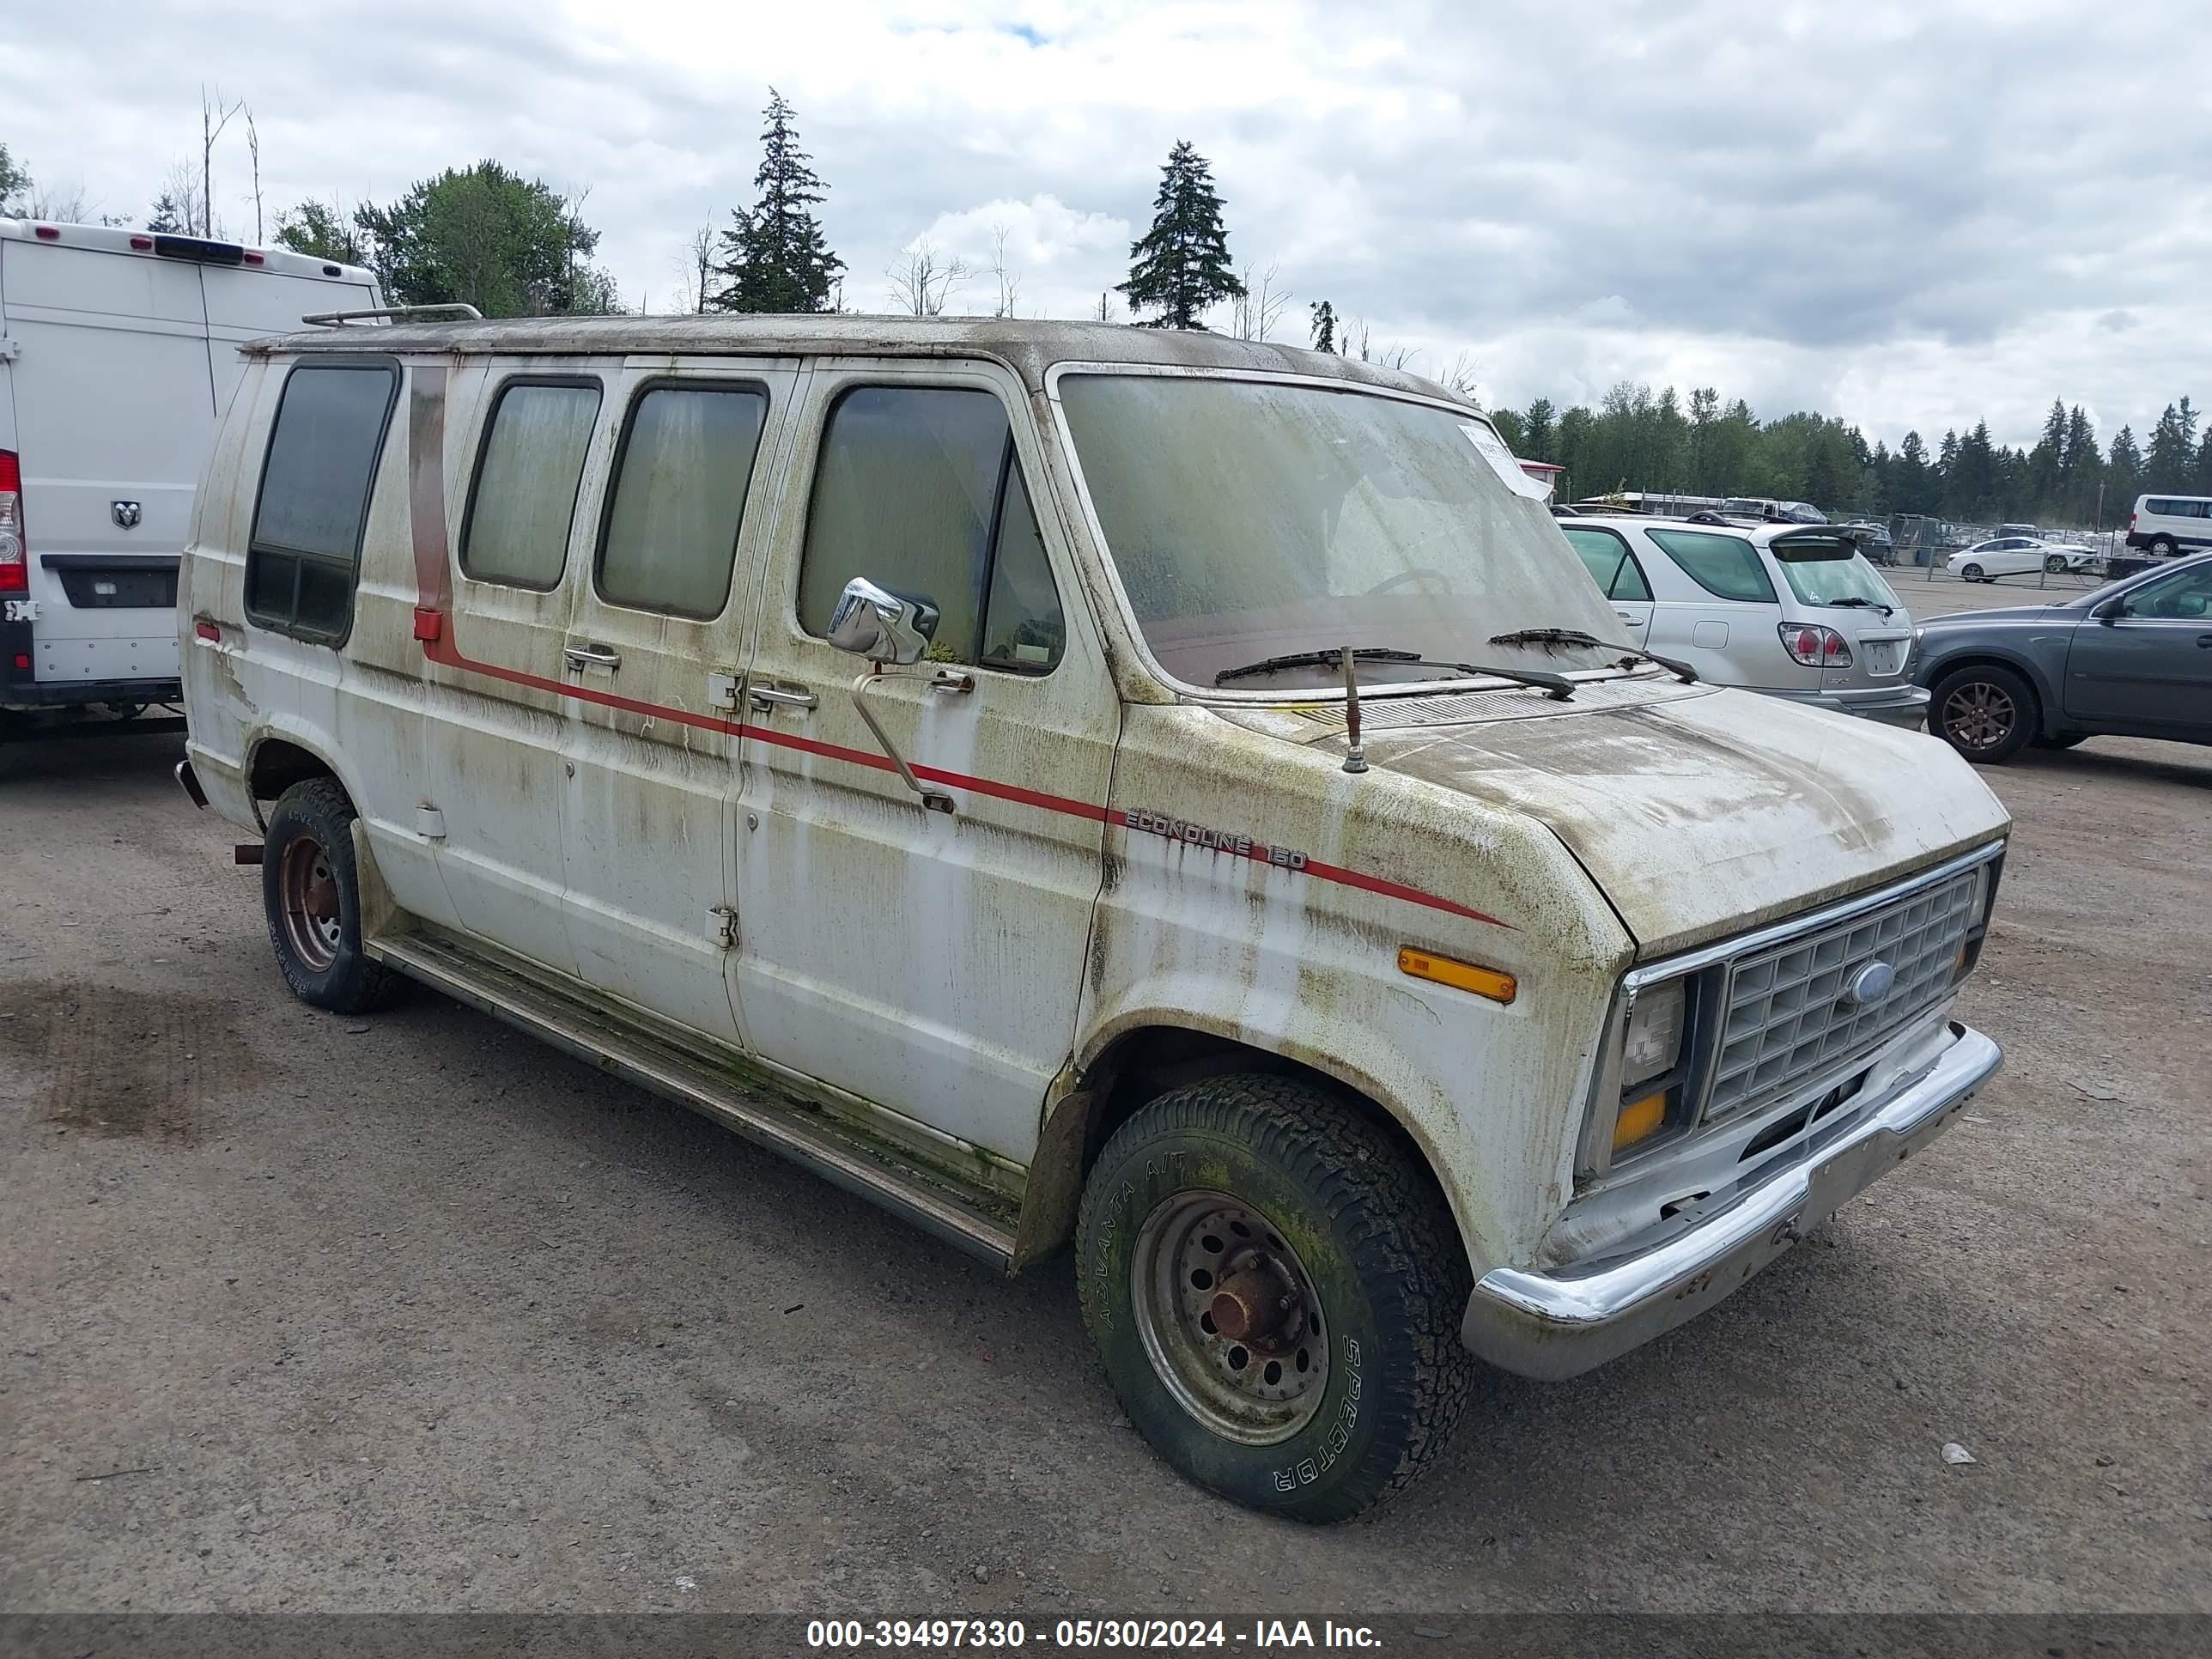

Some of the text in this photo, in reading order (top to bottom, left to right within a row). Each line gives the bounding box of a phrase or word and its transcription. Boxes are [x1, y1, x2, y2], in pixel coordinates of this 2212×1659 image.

[1125, 811, 1308, 870] ECONOLINE 150
[1096, 1151, 1187, 1330] ADVANTA A/T
[1273, 1335, 1362, 1492] SPECTOR
